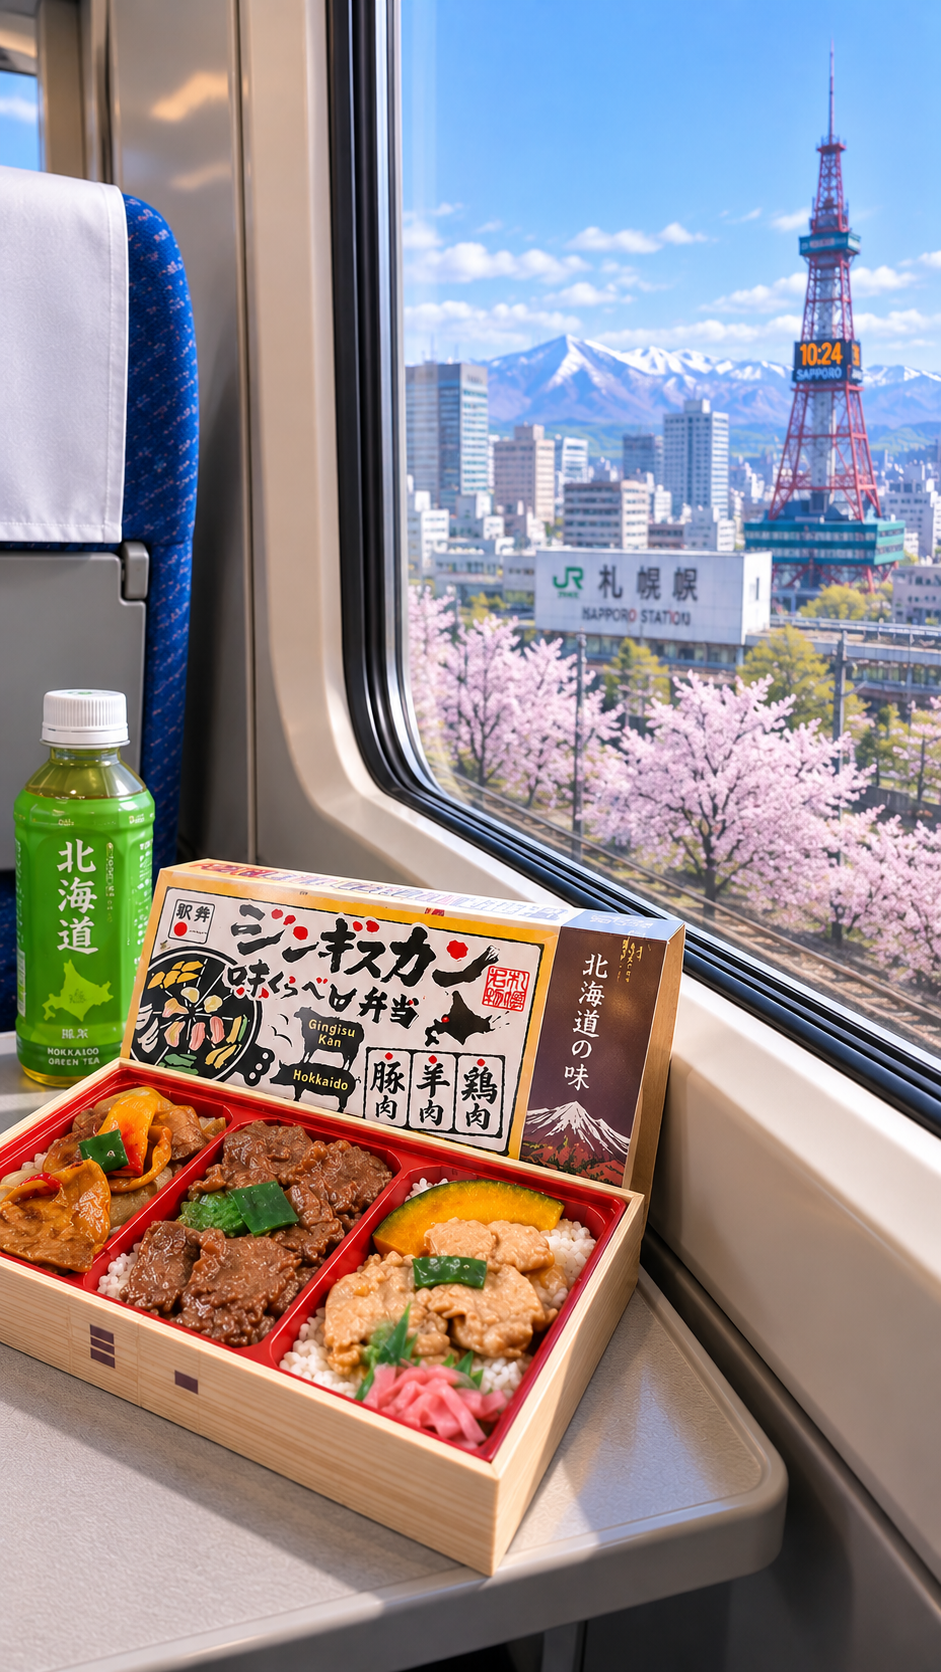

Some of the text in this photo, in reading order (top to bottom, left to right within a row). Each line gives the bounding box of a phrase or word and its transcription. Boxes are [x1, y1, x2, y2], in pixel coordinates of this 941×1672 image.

[800, 342, 843, 366] 10:24
[796, 367, 842, 381] SAPPORO
[553, 566, 583, 590] JR
[641, 610, 691, 626] STATION
[57, 839, 99, 954] 北海道
[230, 904, 500, 987] ジンギスカン
[309, 1019, 356, 1038] Gingisu
[564, 953, 609, 1091] 北海道の味
[318, 1034, 342, 1048] Kan
[293, 1069, 349, 1091] Hokkaido
[370, 1060, 405, 1120] 豚肉
[416, 1062, 450, 1126] 羊肉
[461, 1065, 498, 1130] 鶏肉
